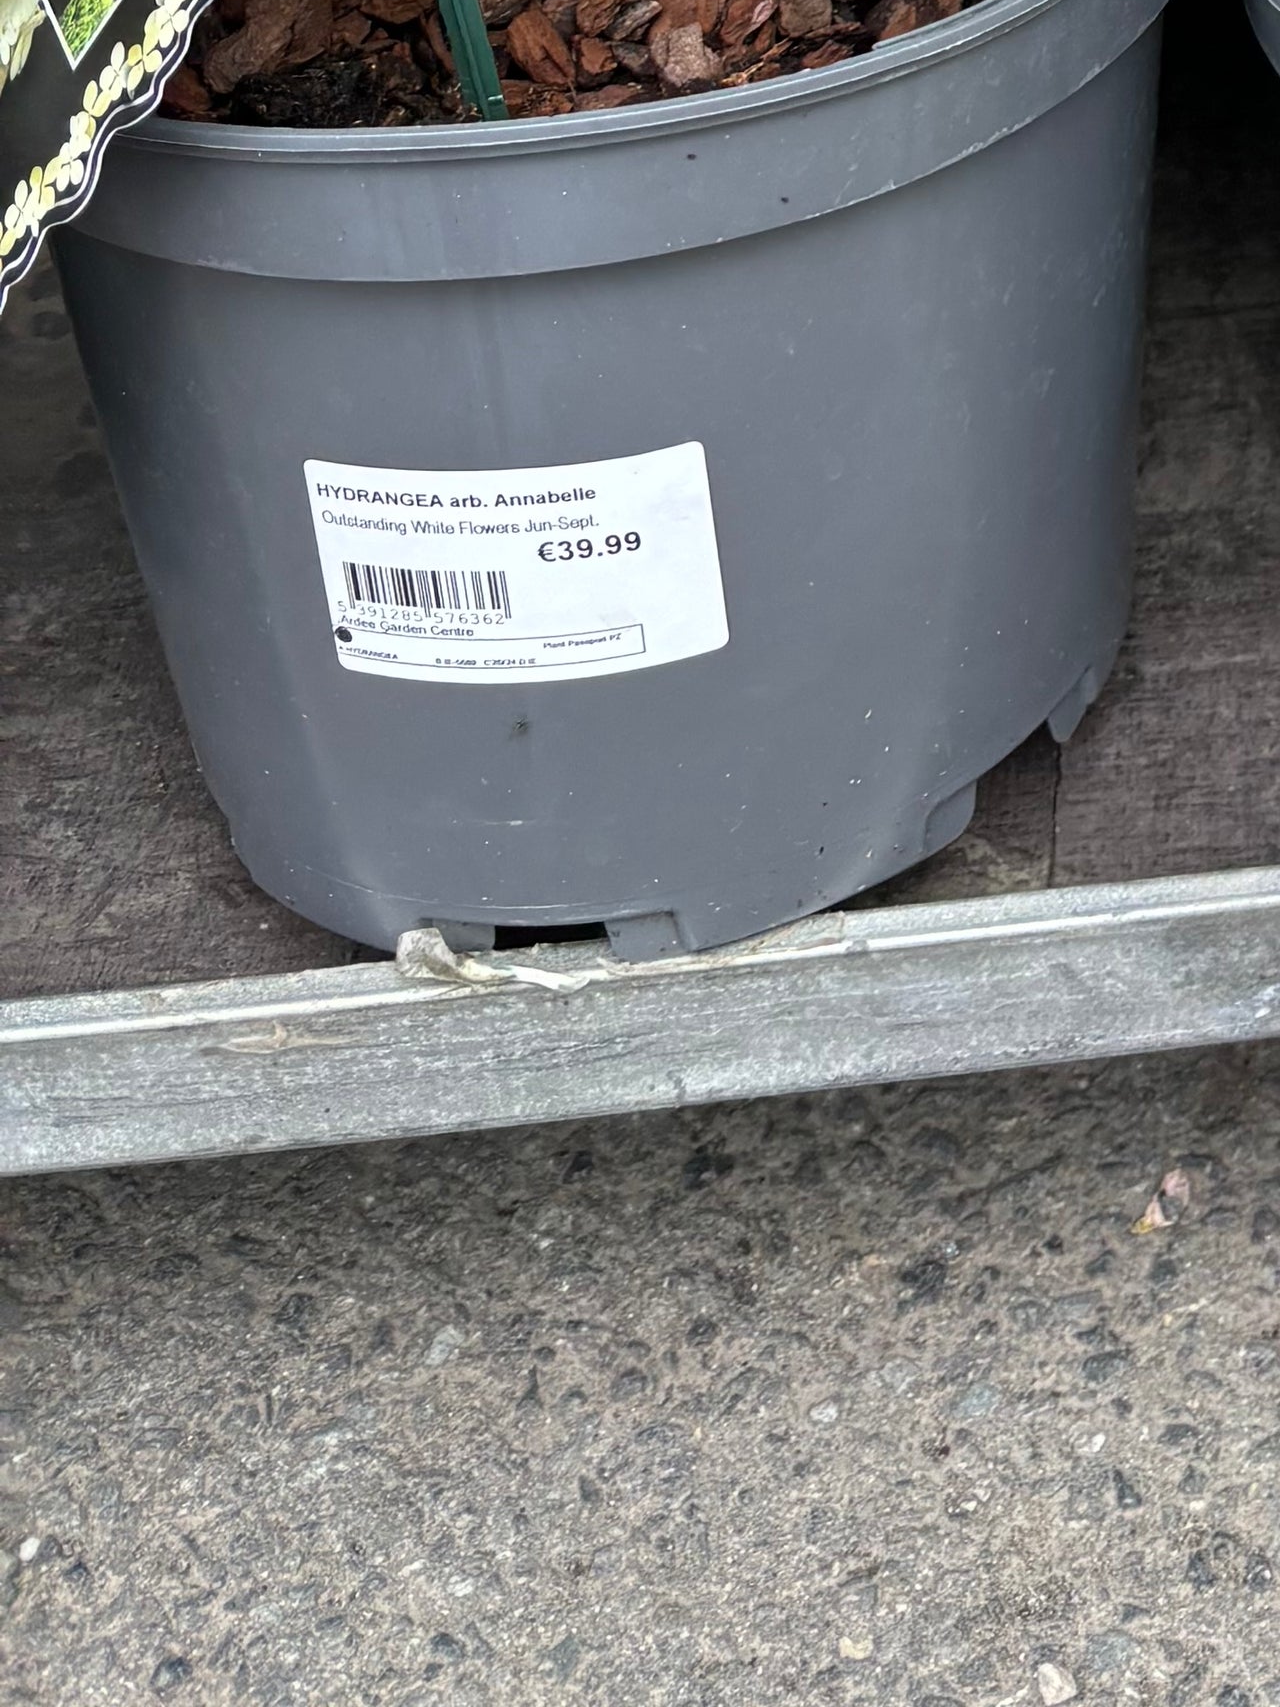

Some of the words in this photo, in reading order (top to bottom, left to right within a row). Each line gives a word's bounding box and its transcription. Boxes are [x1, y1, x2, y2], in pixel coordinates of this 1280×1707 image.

[316, 482, 444, 508] HYDRANGEA
[449, 494, 488, 508] arb.
[494, 487, 597, 508] Annabelle
[321, 509, 407, 536] Outstanding
[410, 519, 455, 535] White
[459, 520, 521, 536] Flowers
[524, 514, 600, 534] Jun-Sept.
[537, 531, 642, 563] €39.99
[337, 600, 348, 613] 5
[358, 605, 424, 623] 391285
[433, 612, 506, 626] 576362
[380, 620, 427, 635] Garden
[430, 625, 475, 637] Centre
